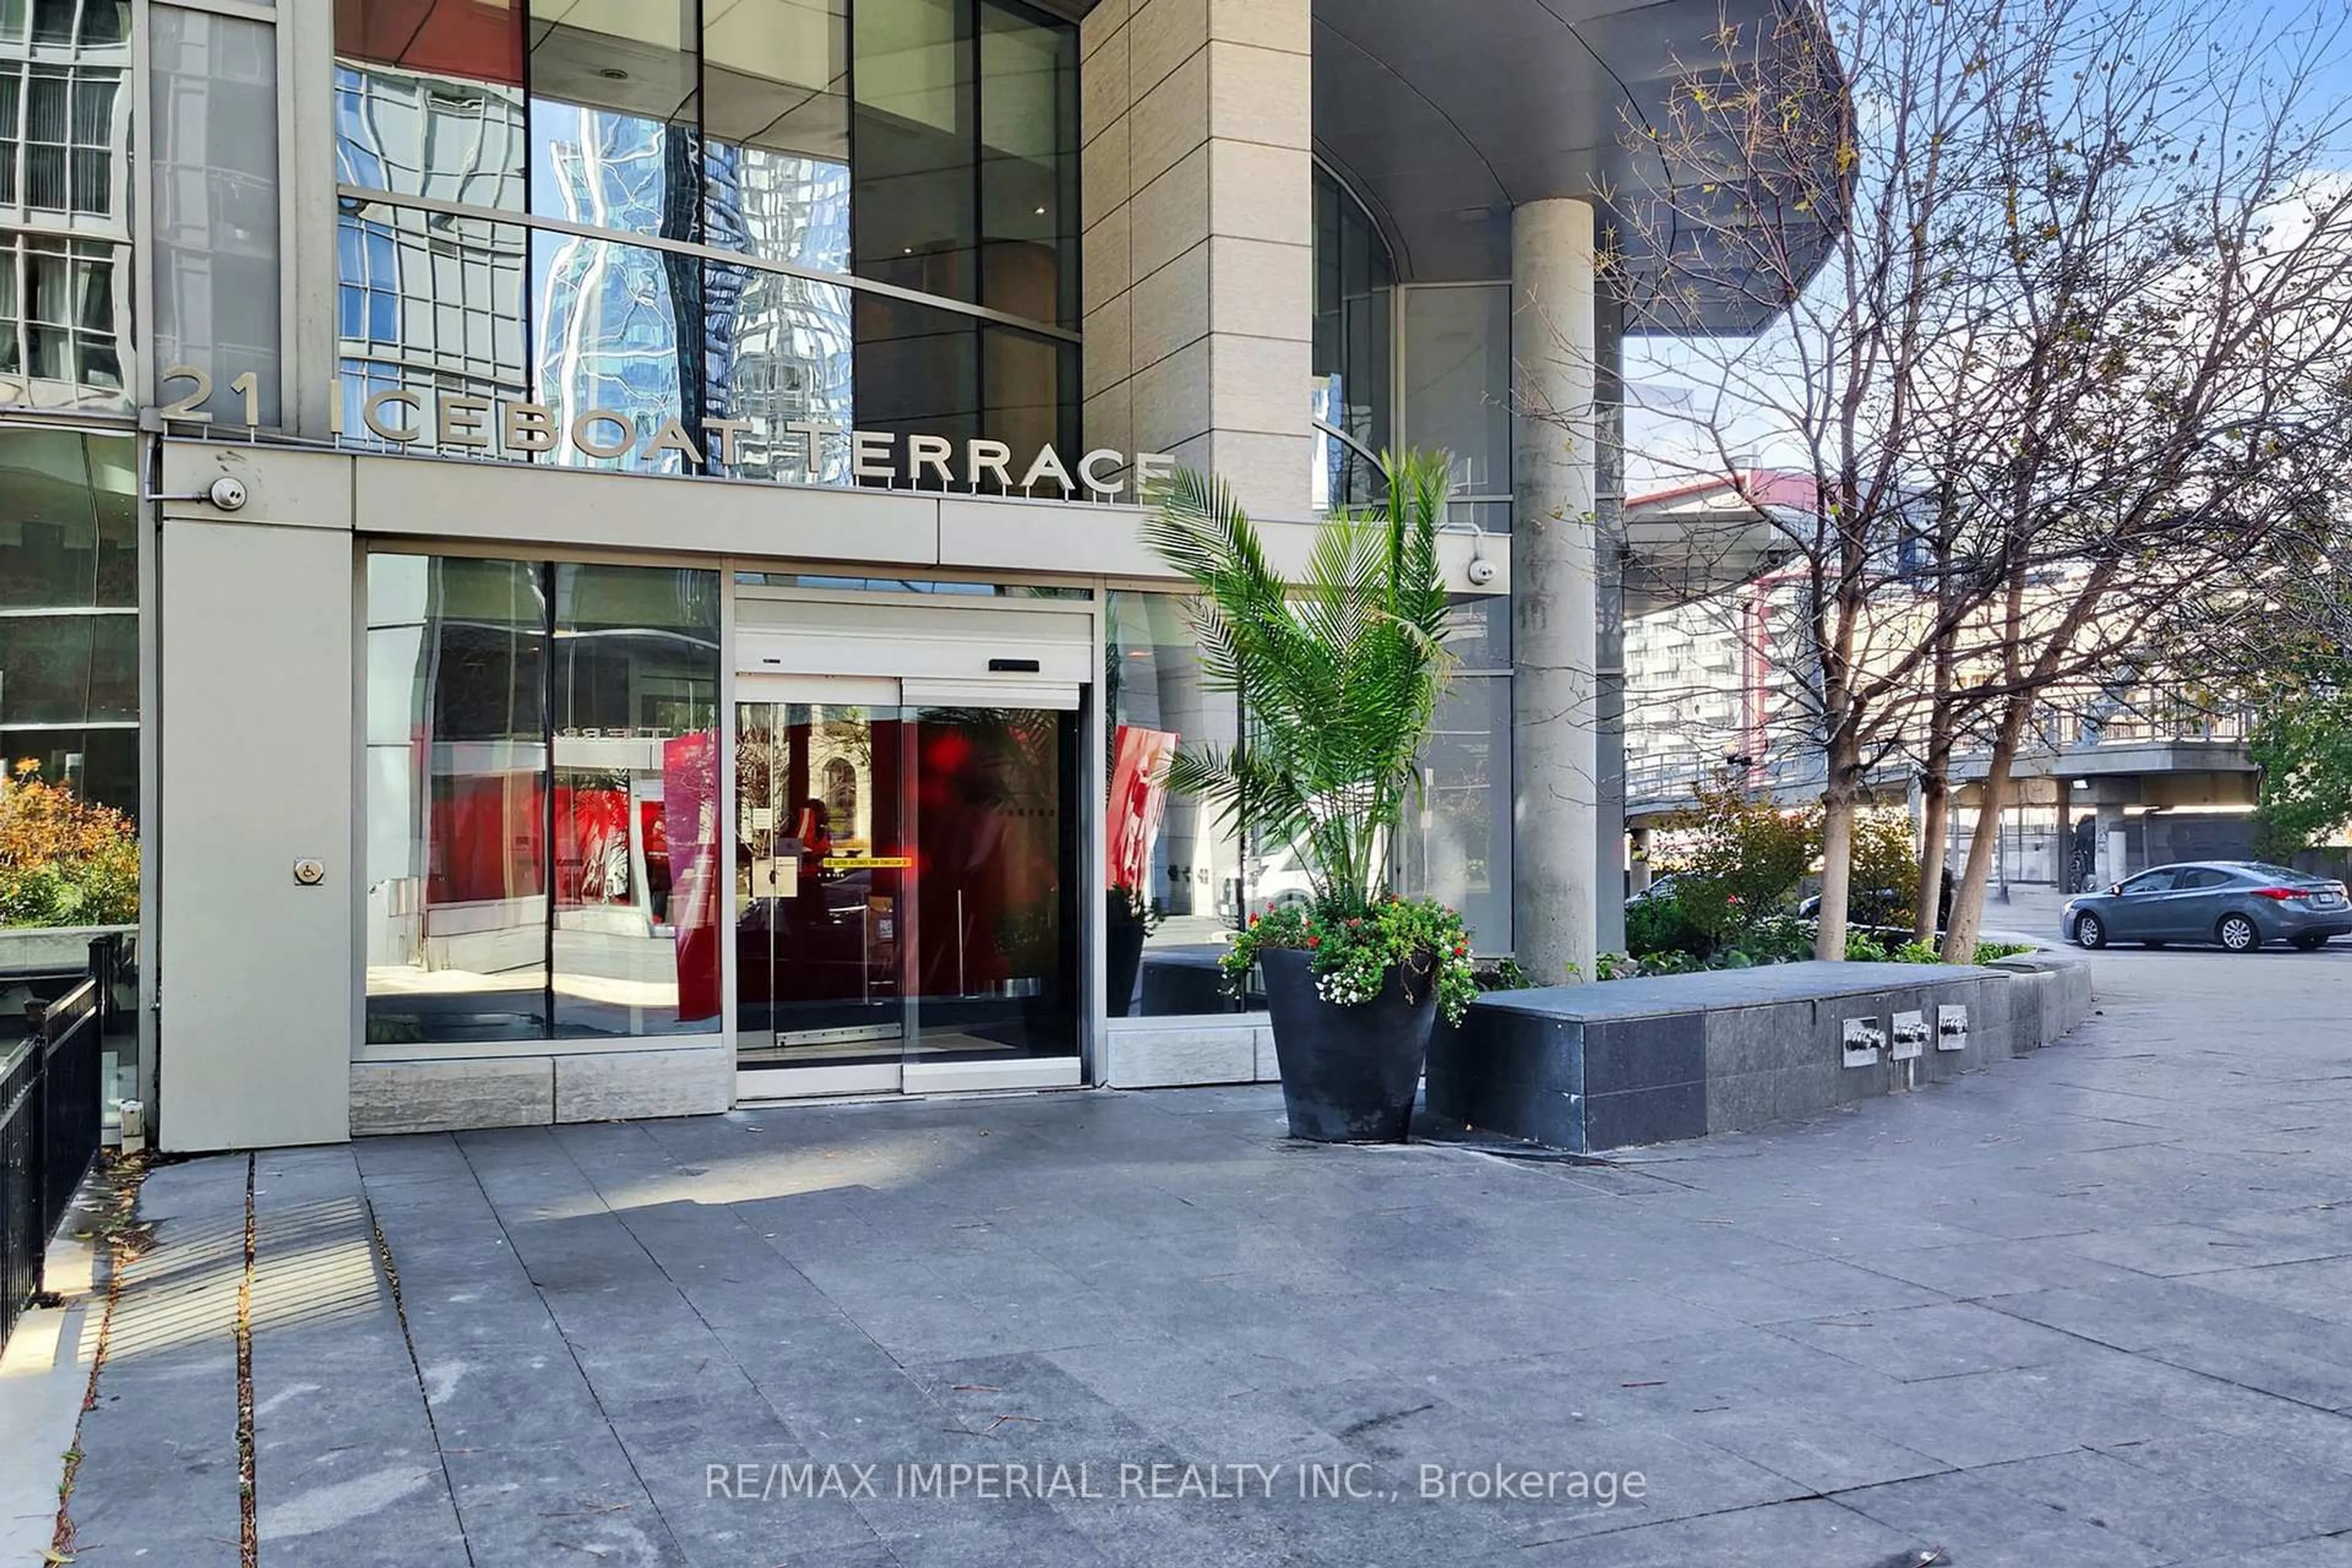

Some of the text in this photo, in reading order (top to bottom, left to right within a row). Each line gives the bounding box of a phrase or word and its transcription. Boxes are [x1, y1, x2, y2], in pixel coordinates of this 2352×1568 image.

[160, 366, 1175, 496] 21 ICEBOAT TERRACE
